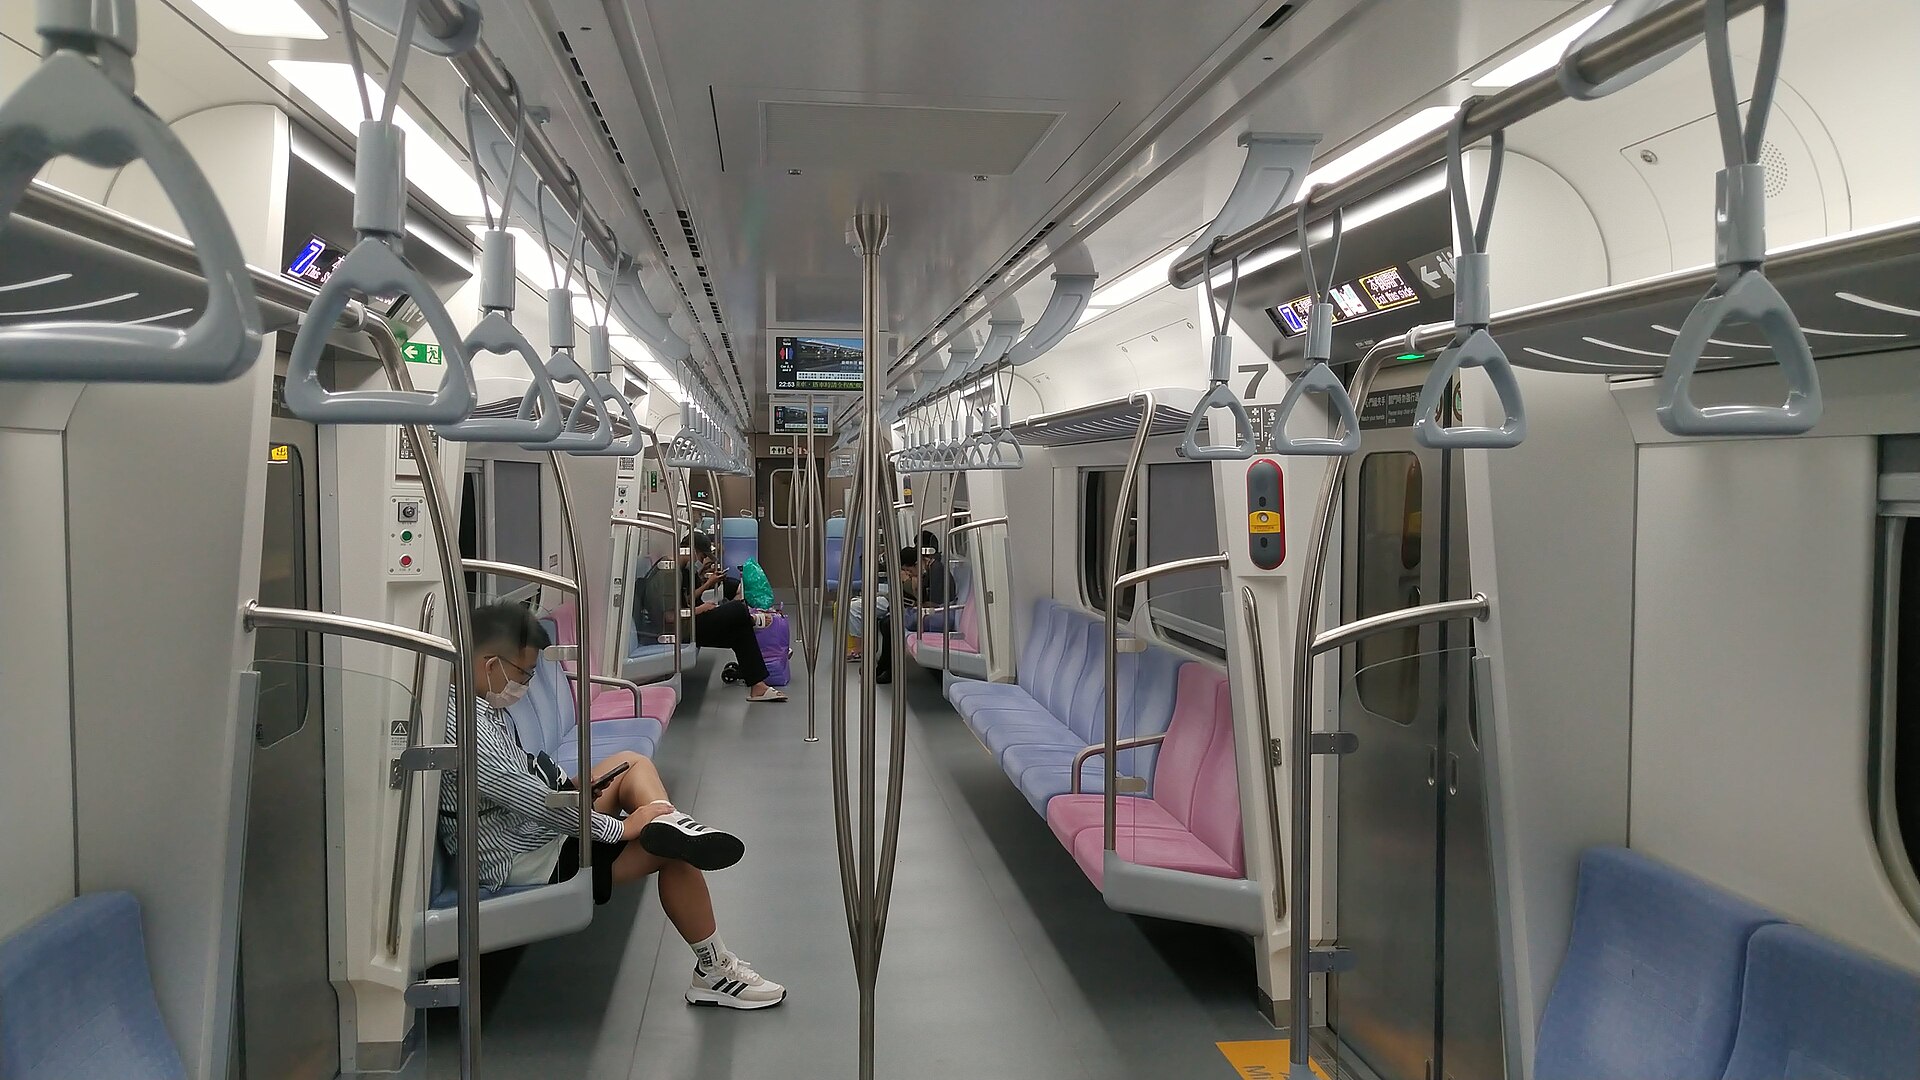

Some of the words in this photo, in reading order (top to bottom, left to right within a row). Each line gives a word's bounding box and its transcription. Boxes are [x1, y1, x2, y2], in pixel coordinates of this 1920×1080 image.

[295, 244, 320, 271] 7
[305, 264, 321, 280] This
[1385, 290, 1399, 302] this
[1397, 285, 1416, 299] side
[1282, 307, 1300, 330] 7
[1237, 363, 1269, 400] 7
